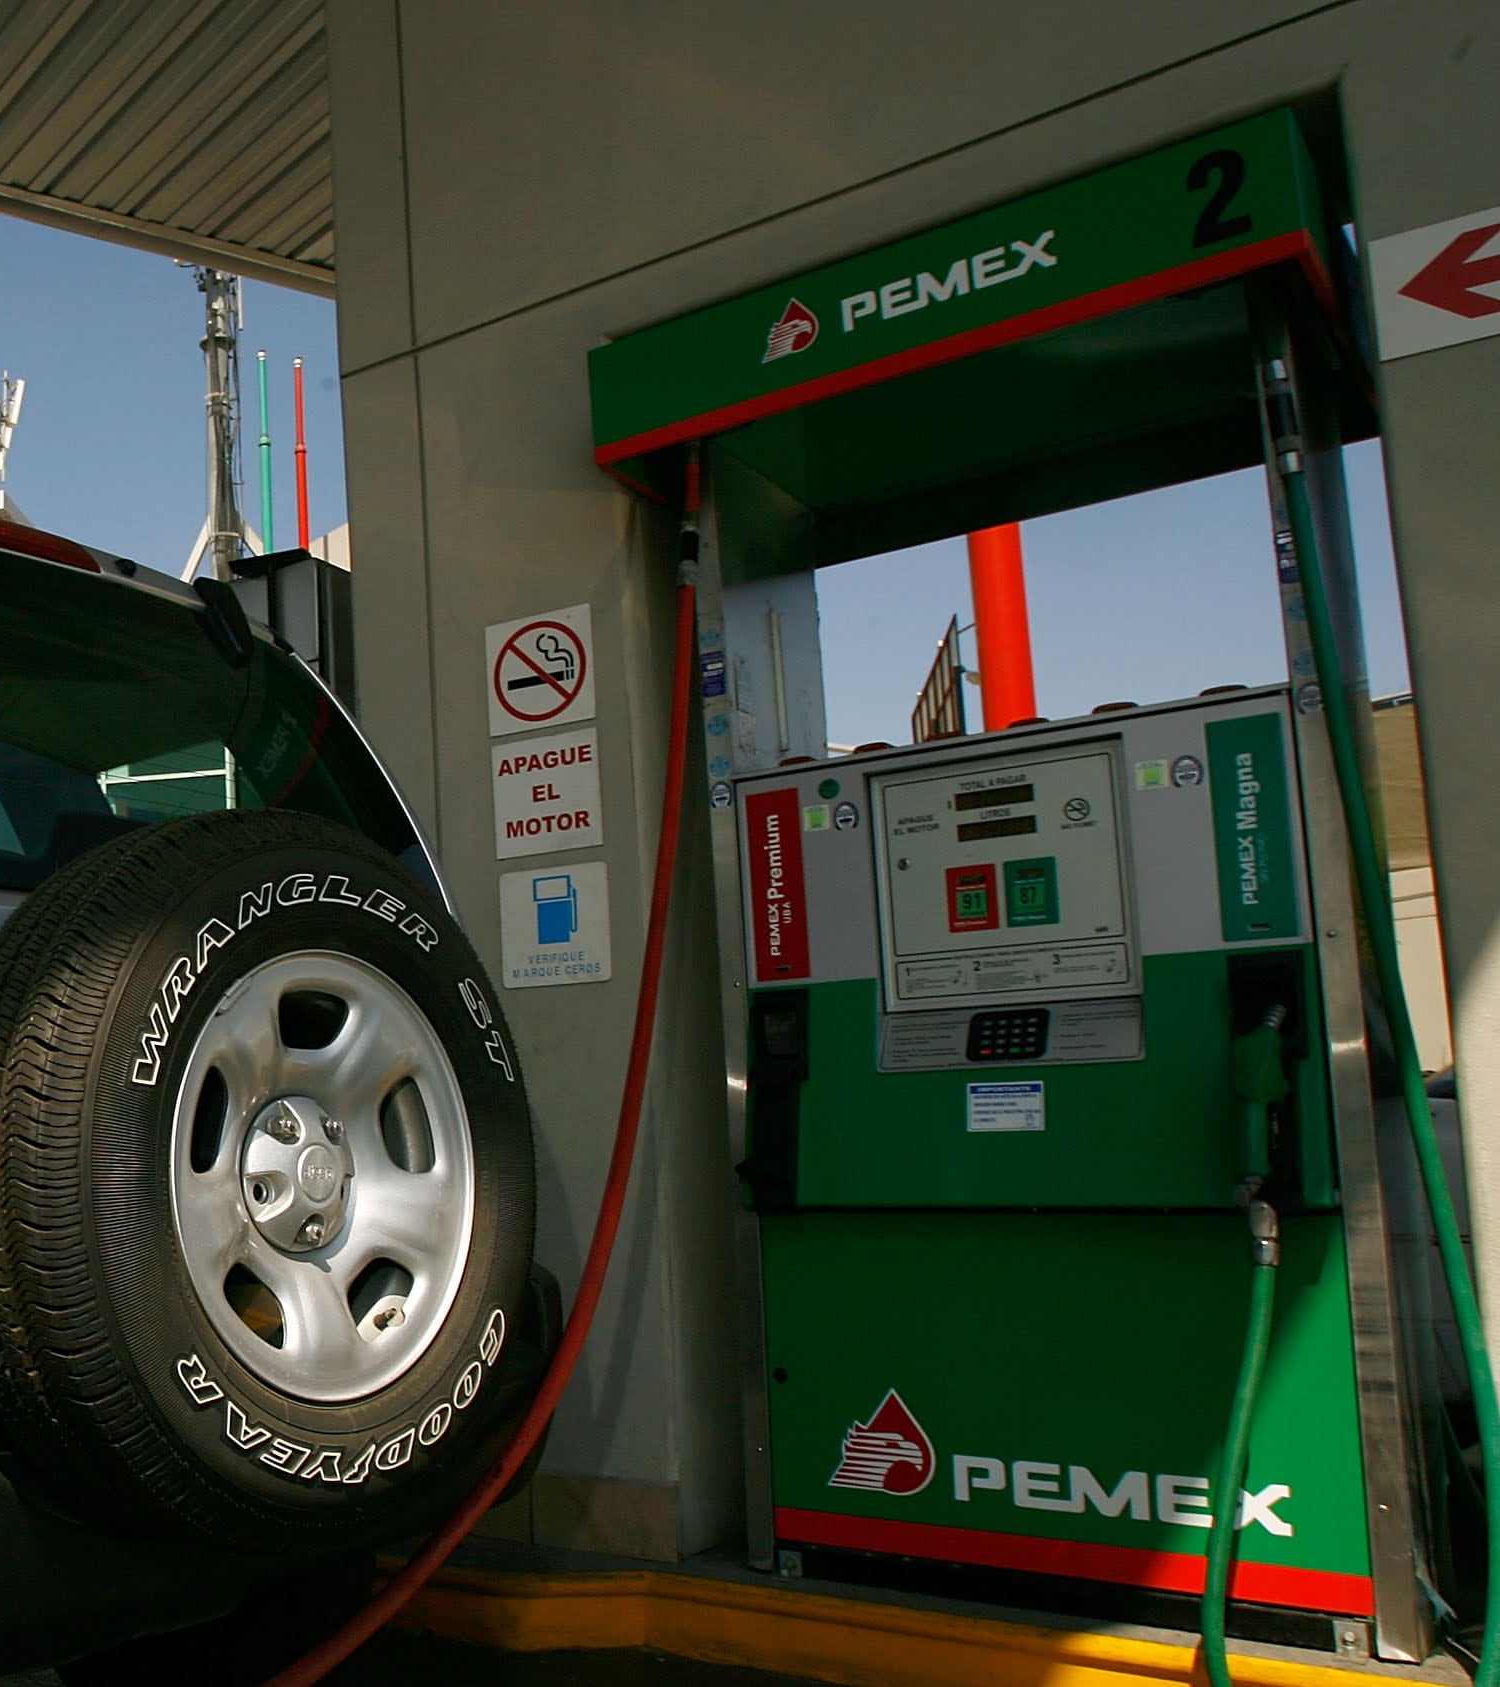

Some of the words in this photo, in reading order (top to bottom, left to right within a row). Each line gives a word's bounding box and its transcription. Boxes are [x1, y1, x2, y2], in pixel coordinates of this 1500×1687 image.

[1186, 150, 1253, 248] 2
[840, 229, 1058, 332] PEMEX
[498, 744, 592, 777] APAGUE
[532, 784, 560, 803] EL
[960, 780, 986, 791] TOTAL
[996, 774, 1027, 785] PAGAR
[1235, 753, 1261, 830] Magna
[506, 810, 590, 839] MOTOR
[898, 814, 934, 825] APAGUE
[980, 808, 1011, 820] LITROS
[894, 827, 905, 836] EL
[907, 823, 940, 834] MOTOR
[764, 814, 785, 899] Premium
[1236, 836, 1259, 905] PEMEX
[963, 892, 982, 910] 91
[1019, 886, 1037, 904] 87
[782, 901, 792, 924] UBA
[767, 903, 782, 956] PEMEX
[528, 951, 585, 965] VERIFIQUE
[973, 961, 981, 971] 2
[1052, 954, 1061, 965] 3
[133, 873, 439, 1085] WRANGLER
[458, 977, 515, 1082] ST
[512, 966, 561, 979] MARQUE
[565, 963, 601, 975] CEROS
[177, 1308, 506, 1484] GOODYEAR
[953, 1454, 1294, 1537] PEMEX
